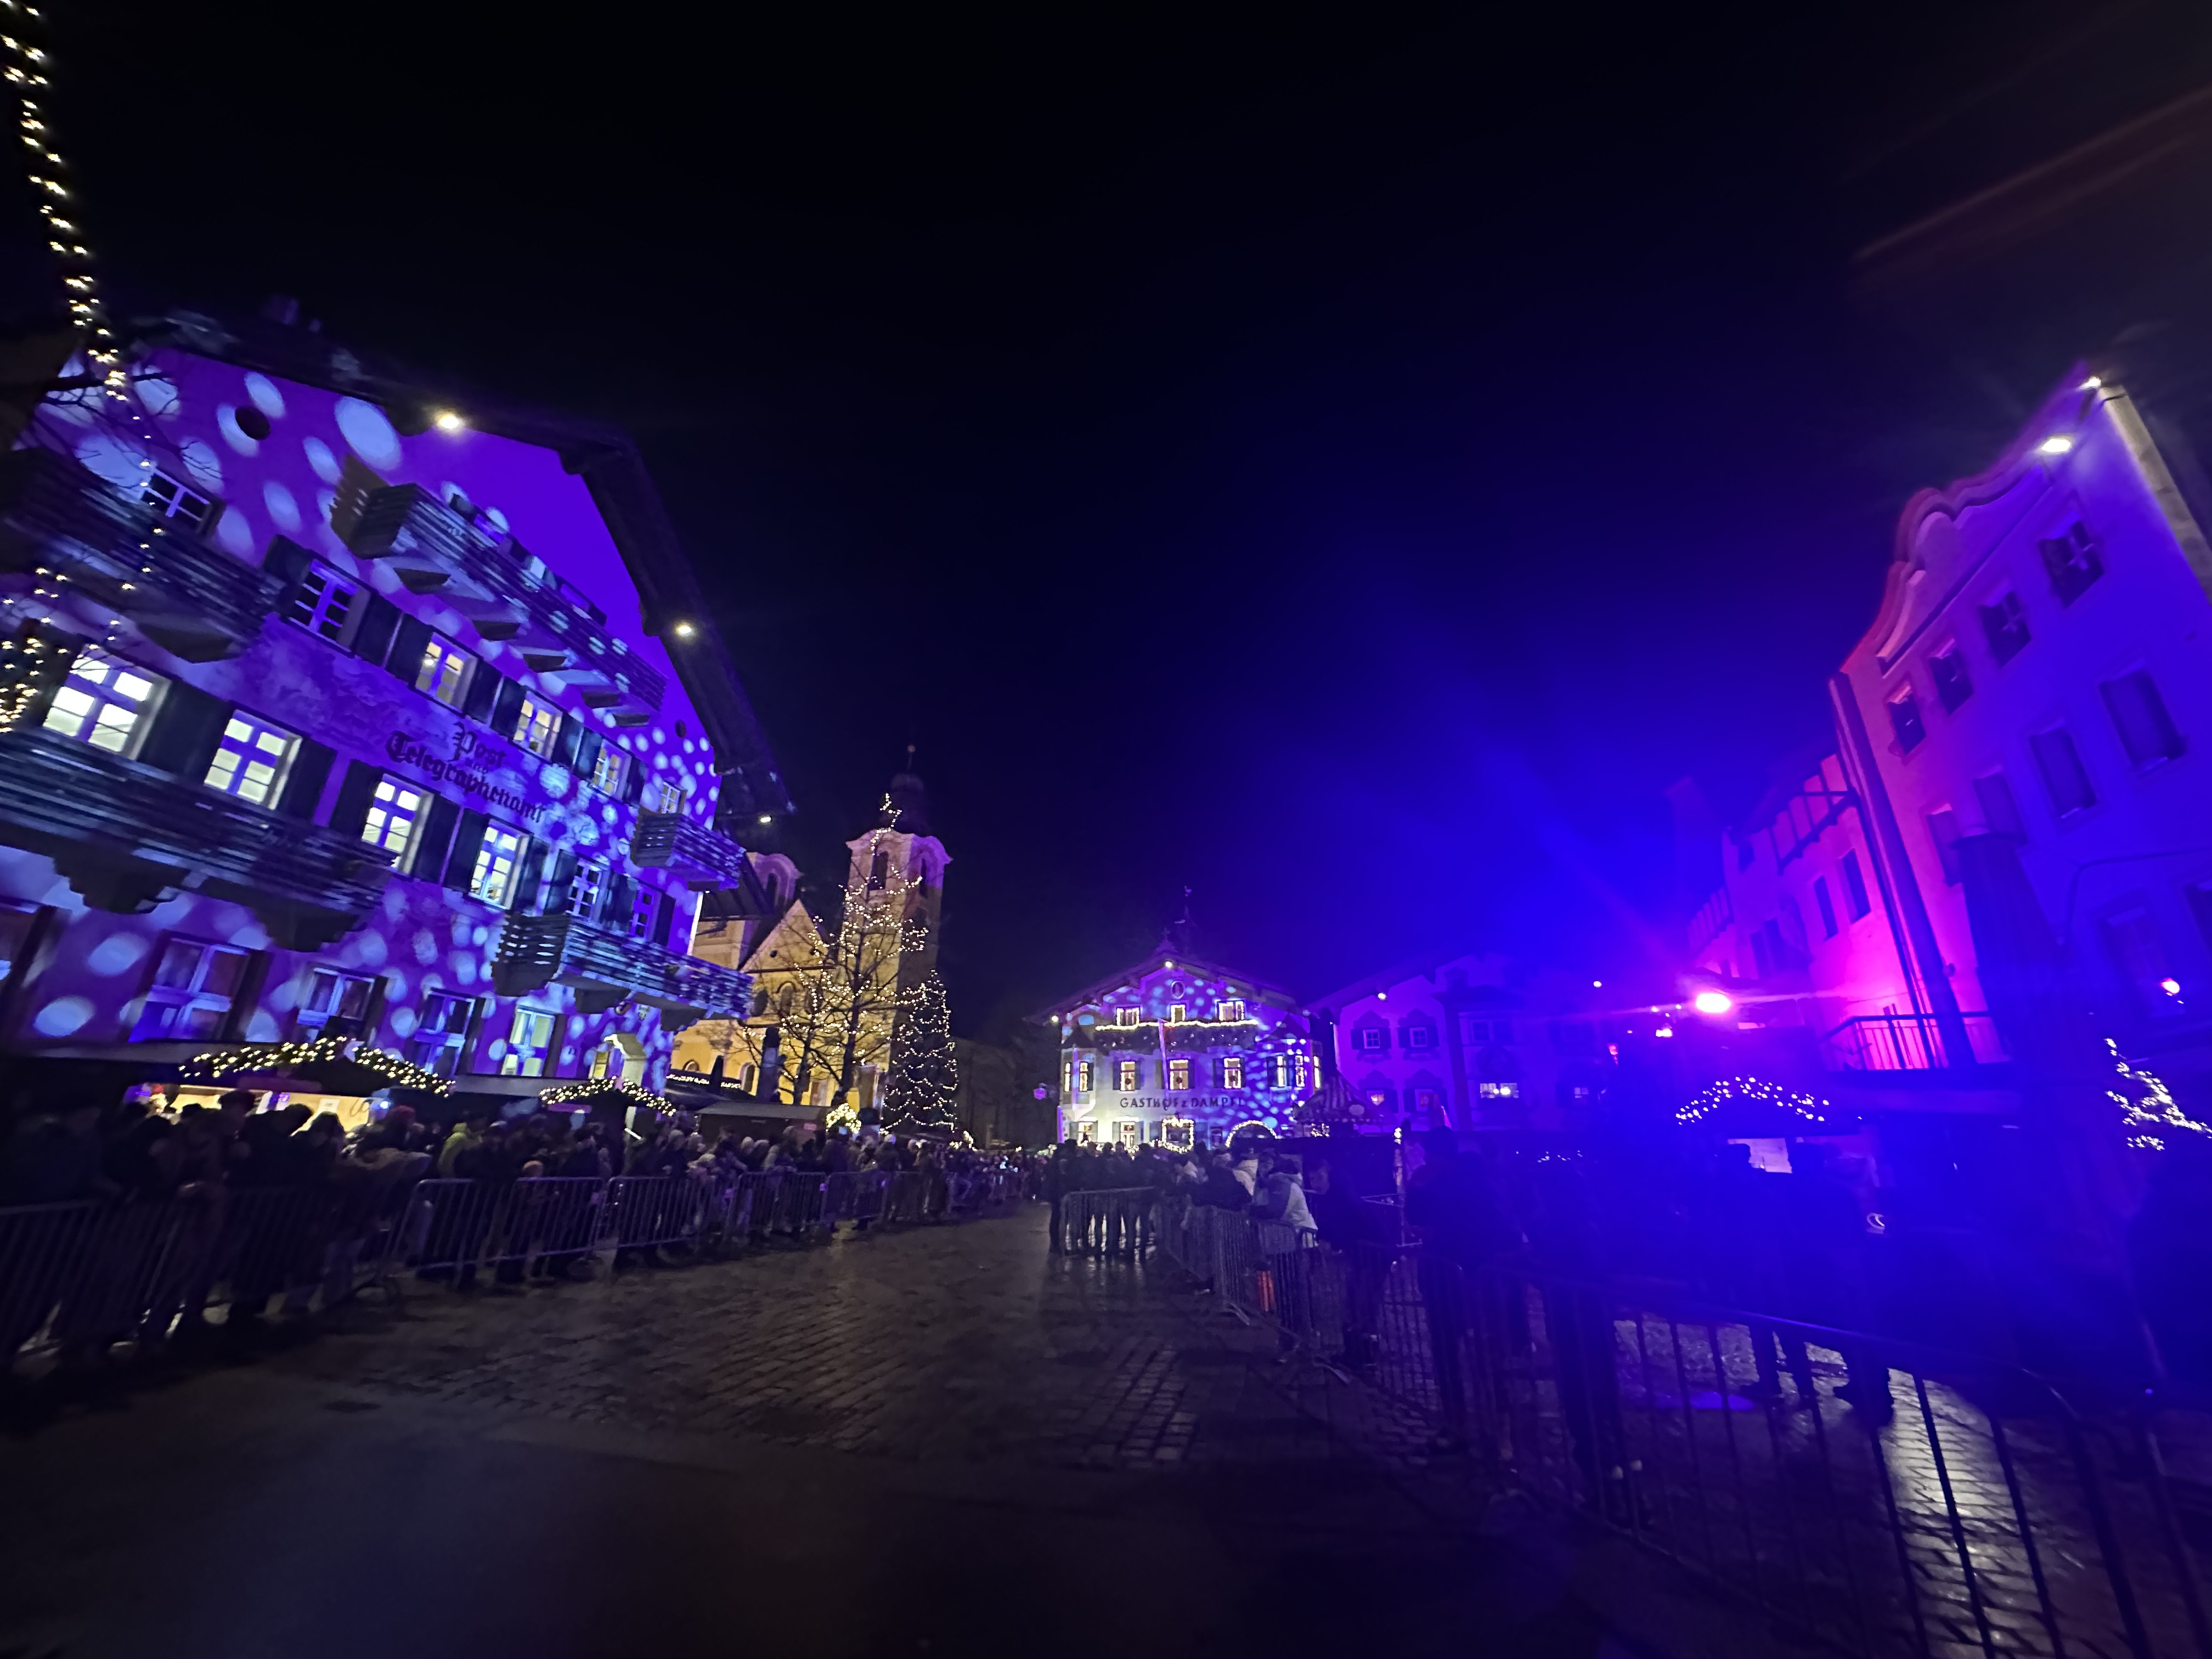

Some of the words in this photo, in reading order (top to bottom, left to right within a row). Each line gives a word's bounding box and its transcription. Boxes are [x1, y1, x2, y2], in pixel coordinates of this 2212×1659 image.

[448, 721, 507, 768] Post
[386, 730, 547, 823] Telegraphenamt
[1120, 1097, 1178, 1108] GASTHOF
